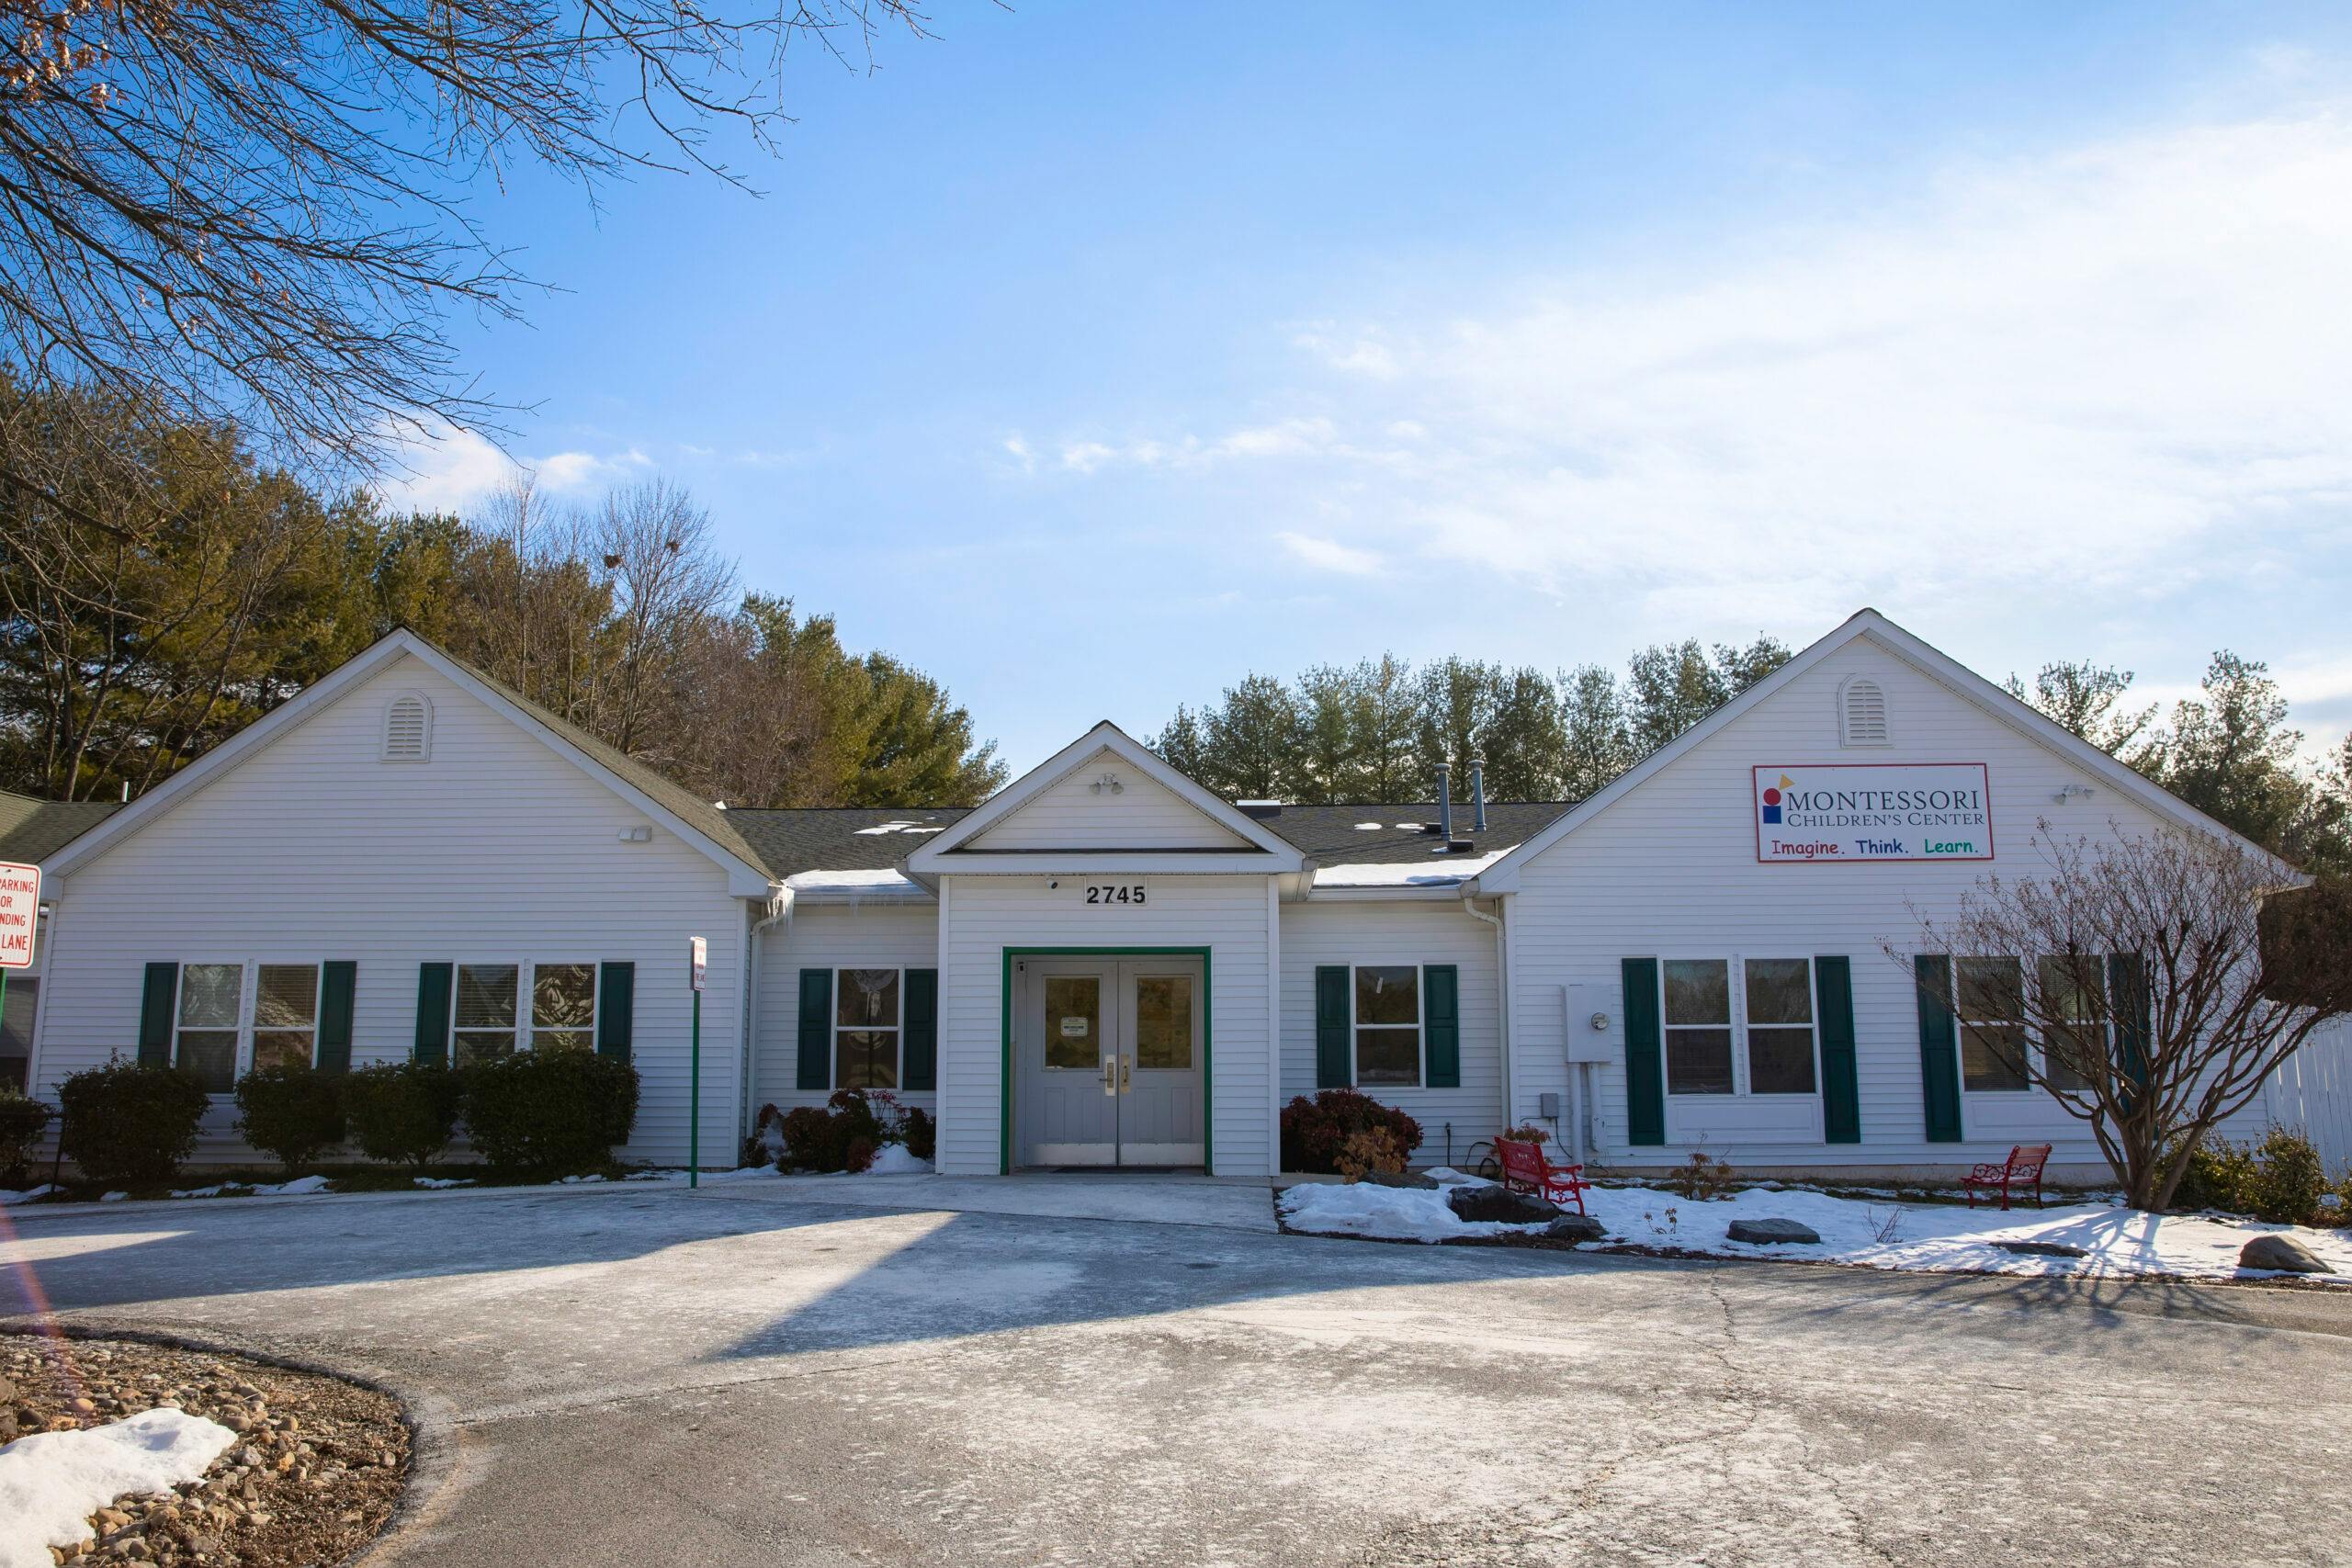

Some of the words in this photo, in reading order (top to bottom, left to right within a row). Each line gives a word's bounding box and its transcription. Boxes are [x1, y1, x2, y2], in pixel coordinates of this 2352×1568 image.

[1787, 790, 1980, 811] MONTESSORI
[1788, 813, 1902, 828] CHILDREN'S
[1907, 812, 1985, 827] CENTER
[1771, 840, 1846, 858] Imagine.
[1855, 838, 1909, 854] Think.
[1925, 838, 1979, 853] Learn.
[0, 896, 13, 908] OR
[1087, 886, 1146, 904] 2745
[2, 933, 28, 951] LANE
